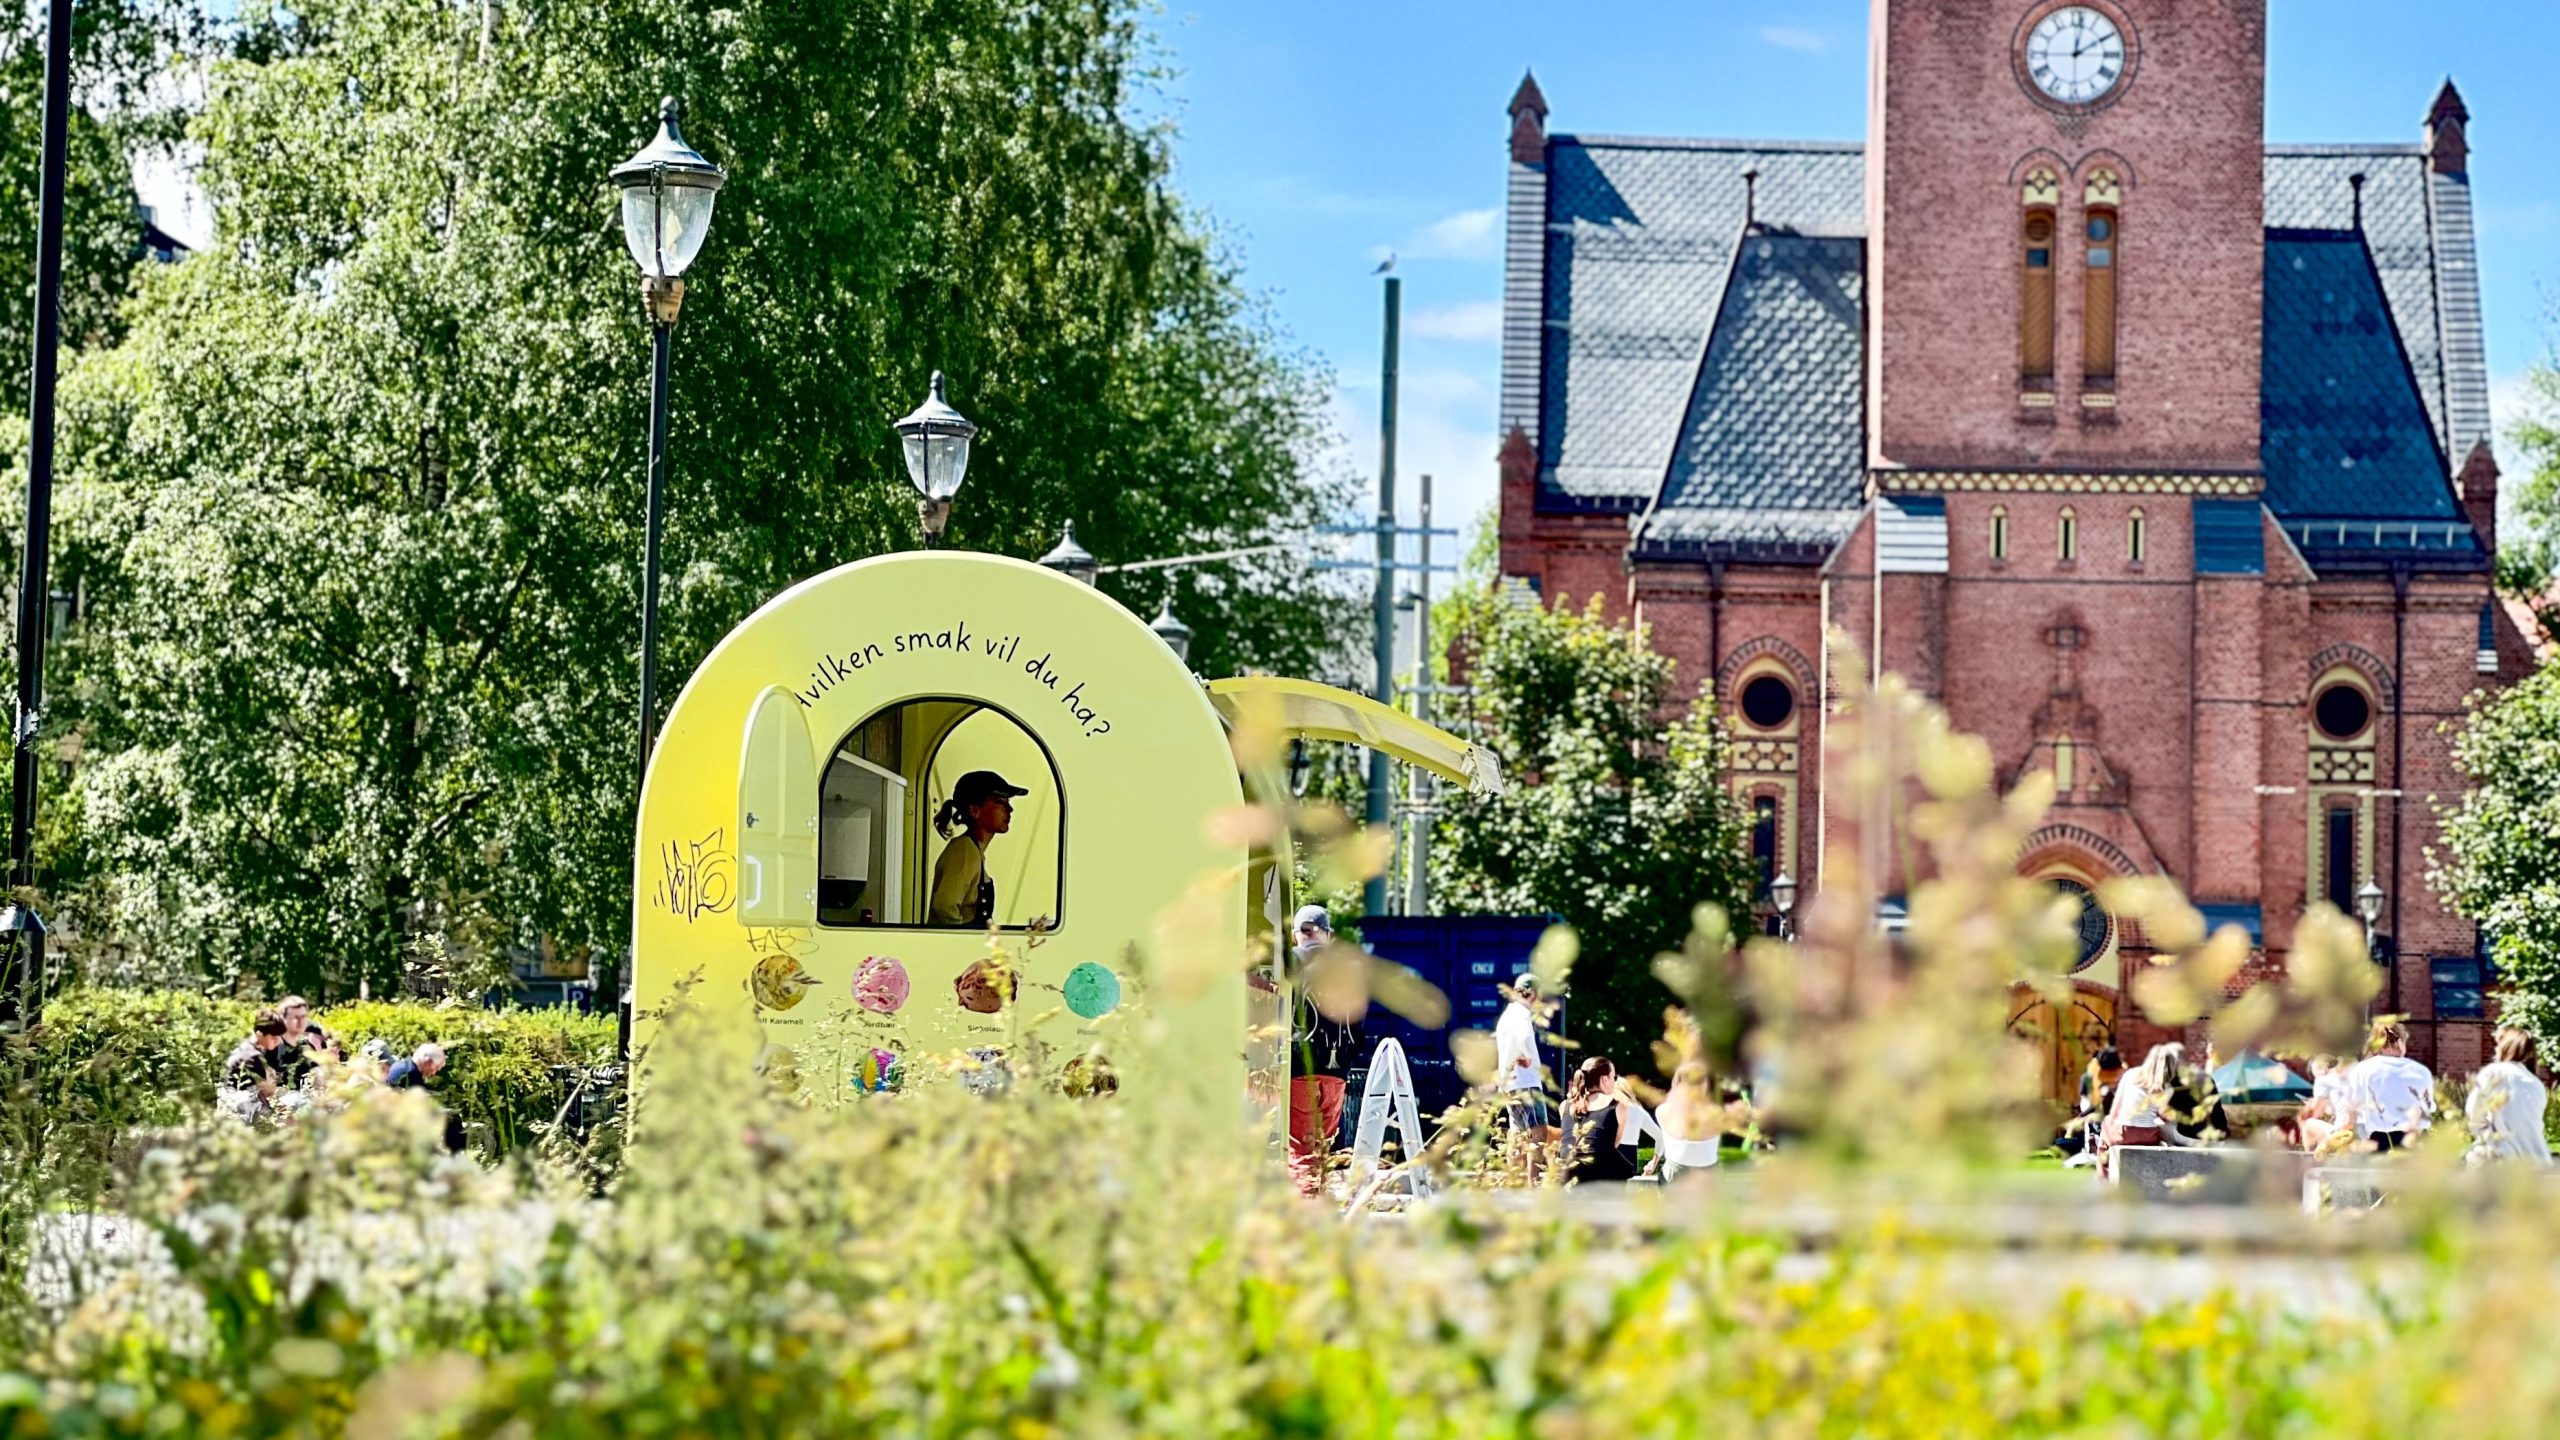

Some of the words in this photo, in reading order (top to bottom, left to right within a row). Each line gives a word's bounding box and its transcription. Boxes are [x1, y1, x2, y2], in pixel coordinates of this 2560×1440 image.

[895, 621, 971, 652] smak
[986, 636, 1020, 663] vil
[1025, 653, 1058, 689] du
[1061, 682, 1111, 738] ha?
[769, 1017, 804, 1025] Karamell
